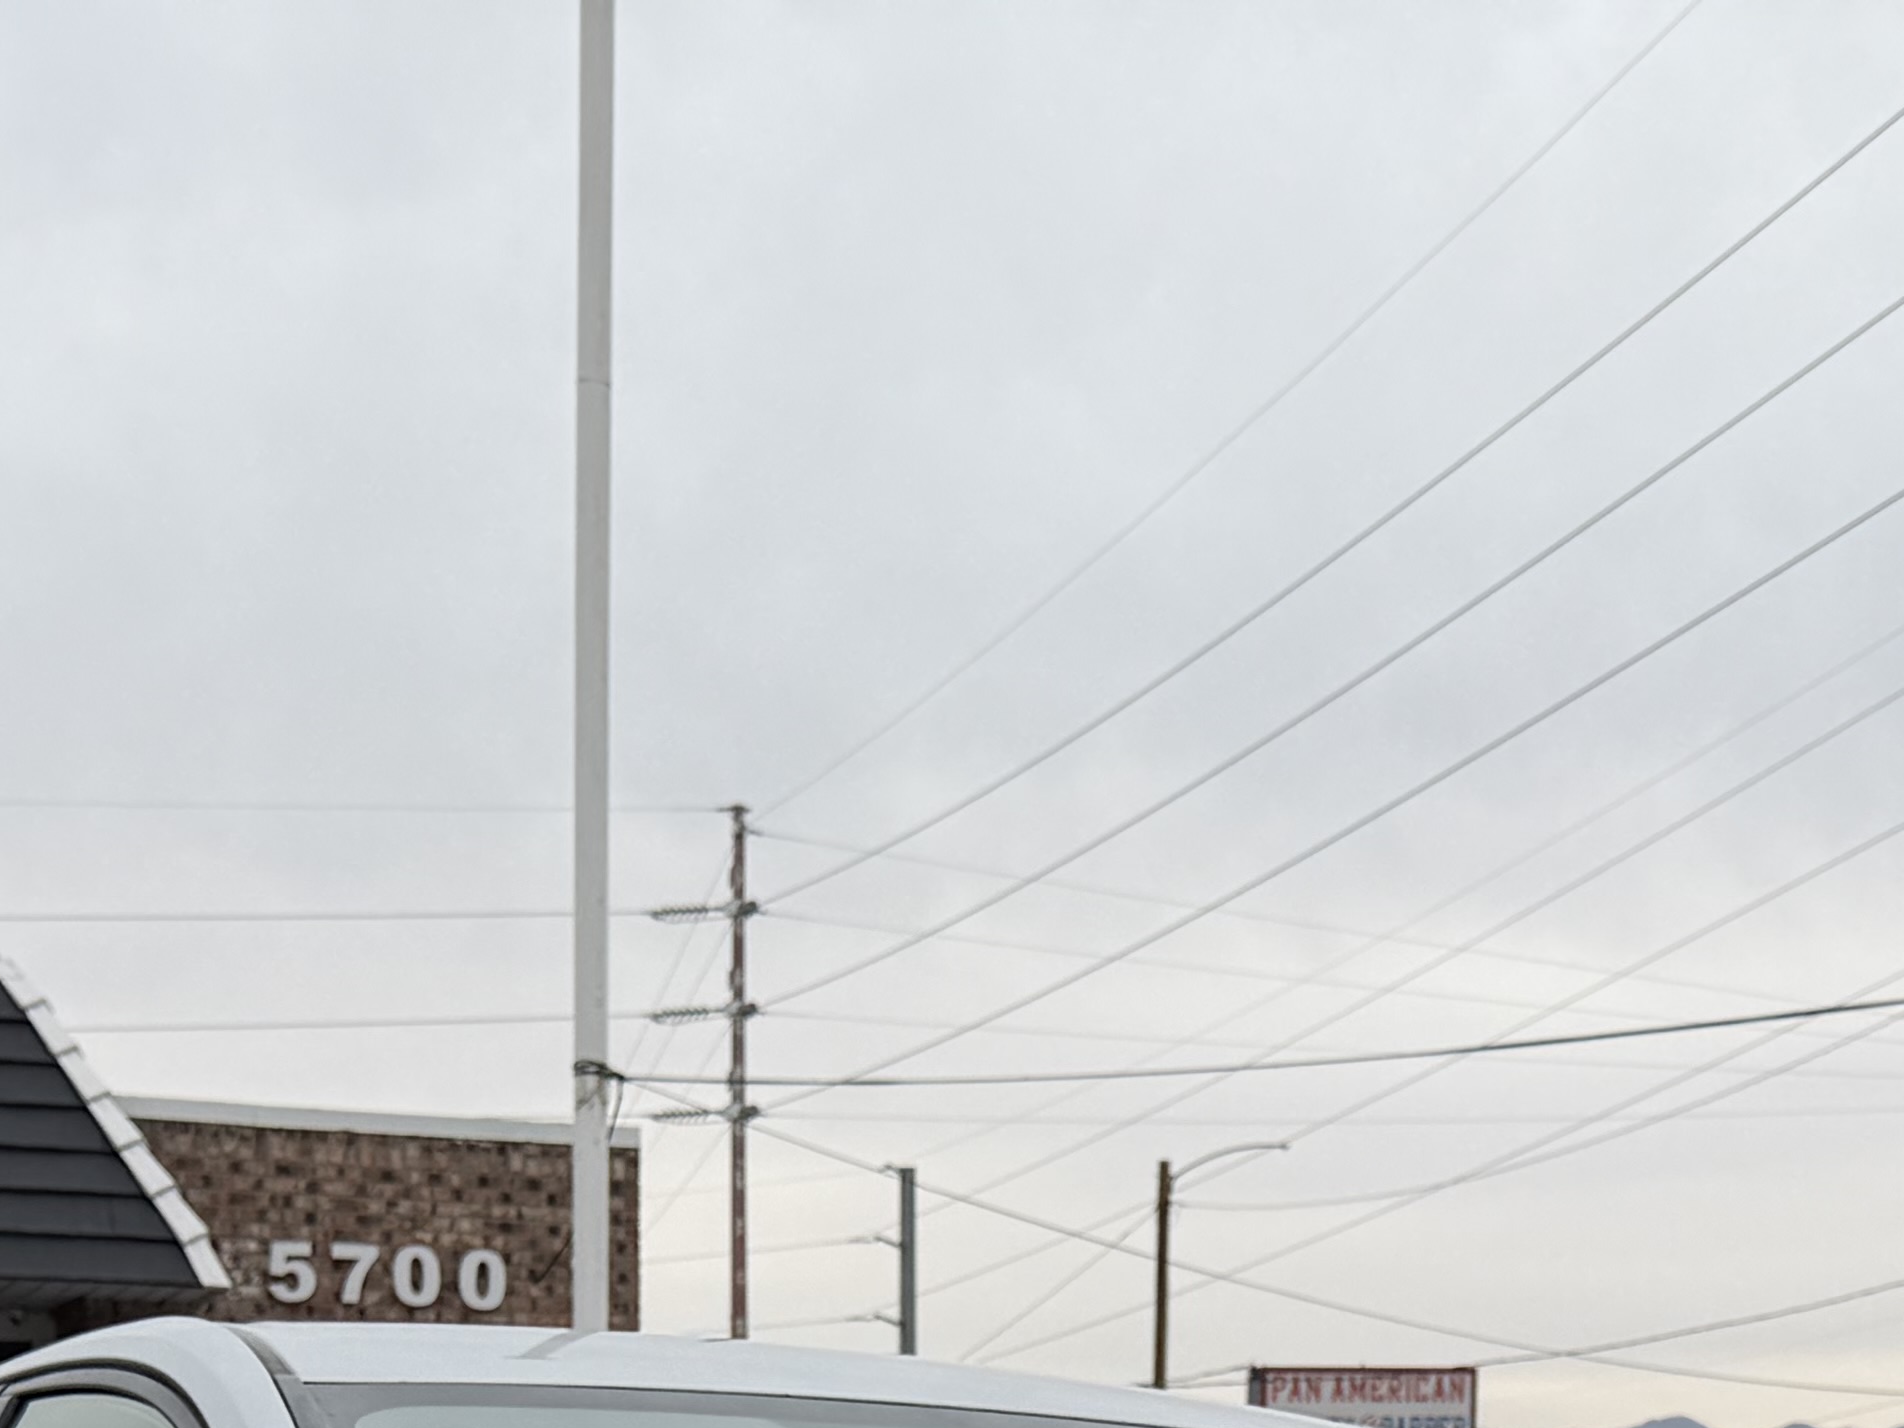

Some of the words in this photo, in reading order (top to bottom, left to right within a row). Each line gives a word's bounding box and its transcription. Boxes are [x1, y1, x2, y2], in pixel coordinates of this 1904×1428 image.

[268, 1241, 508, 1312] 5700
[1271, 1375, 1322, 1405] PAN
[1332, 1374, 1466, 1405] AMERICAN
